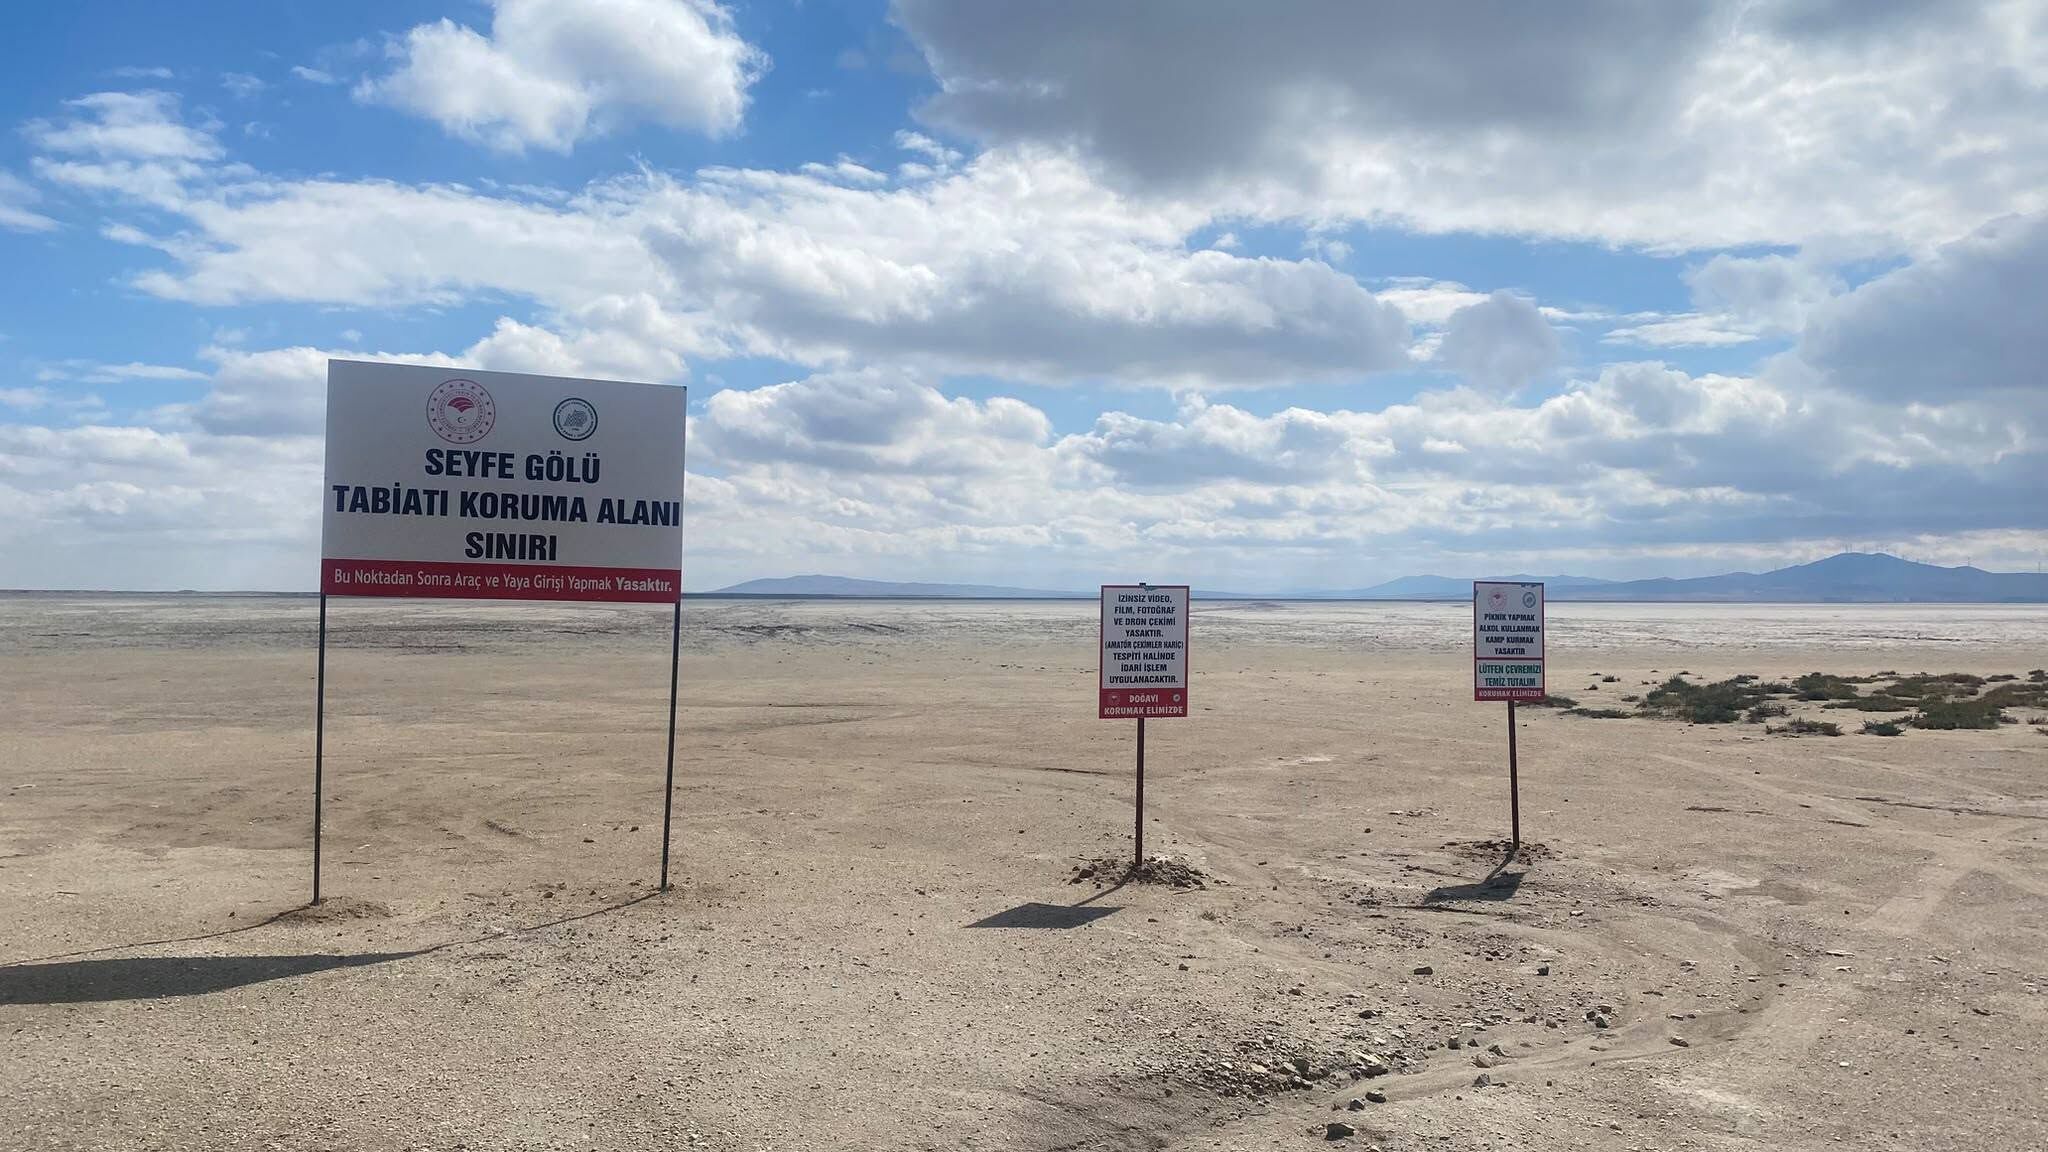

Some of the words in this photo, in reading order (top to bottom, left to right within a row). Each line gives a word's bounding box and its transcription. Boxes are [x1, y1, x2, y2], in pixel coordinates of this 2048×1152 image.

[425, 449, 515, 479] SEYFE
[525, 451, 600, 484] GÖLÜ
[332, 482, 448, 516] TABİATI
[460, 491, 587, 522] KORUMA
[597, 498, 680, 526] ALANI
[465, 532, 557, 561] SINIRI
[334, 568, 350, 583] Bu
[354, 570, 413, 585] Noktadan
[417, 571, 451, 586] Sonra
[454, 573, 481, 590] Araç
[485, 576, 499, 588] ve
[503, 573, 530, 591] Yaya
[533, 574, 564, 592] Girişi
[568, 575, 612, 593] Yapmak
[615, 576, 673, 592] Yasaktır.
[1137, 605, 1176, 614] FOTOĞRAF
[1113, 617, 1123, 626] VE
[1125, 617, 1147, 626] DRON
[1149, 616, 1176, 627] ÇEKİMİ
[1508, 613, 1535, 621] YAPMAK
[1125, 629, 1164, 638] YASAKTIR.
[1113, 651, 1141, 660] TESPİTİ
[1143, 651, 1176, 660] HALİNDE
[1121, 663, 1141, 672] İDARİ
[1144, 663, 1167, 673] İŞLEM
[1479, 663, 1504, 673] LÜTFEN
[1109, 675, 1178, 684] UYGULANACAKTIR.
[1485, 676, 1505, 686] TEMİZ
[1104, 706, 1144, 715] KORUMAK
[1146, 705, 1183, 714] ELİMİZDE
